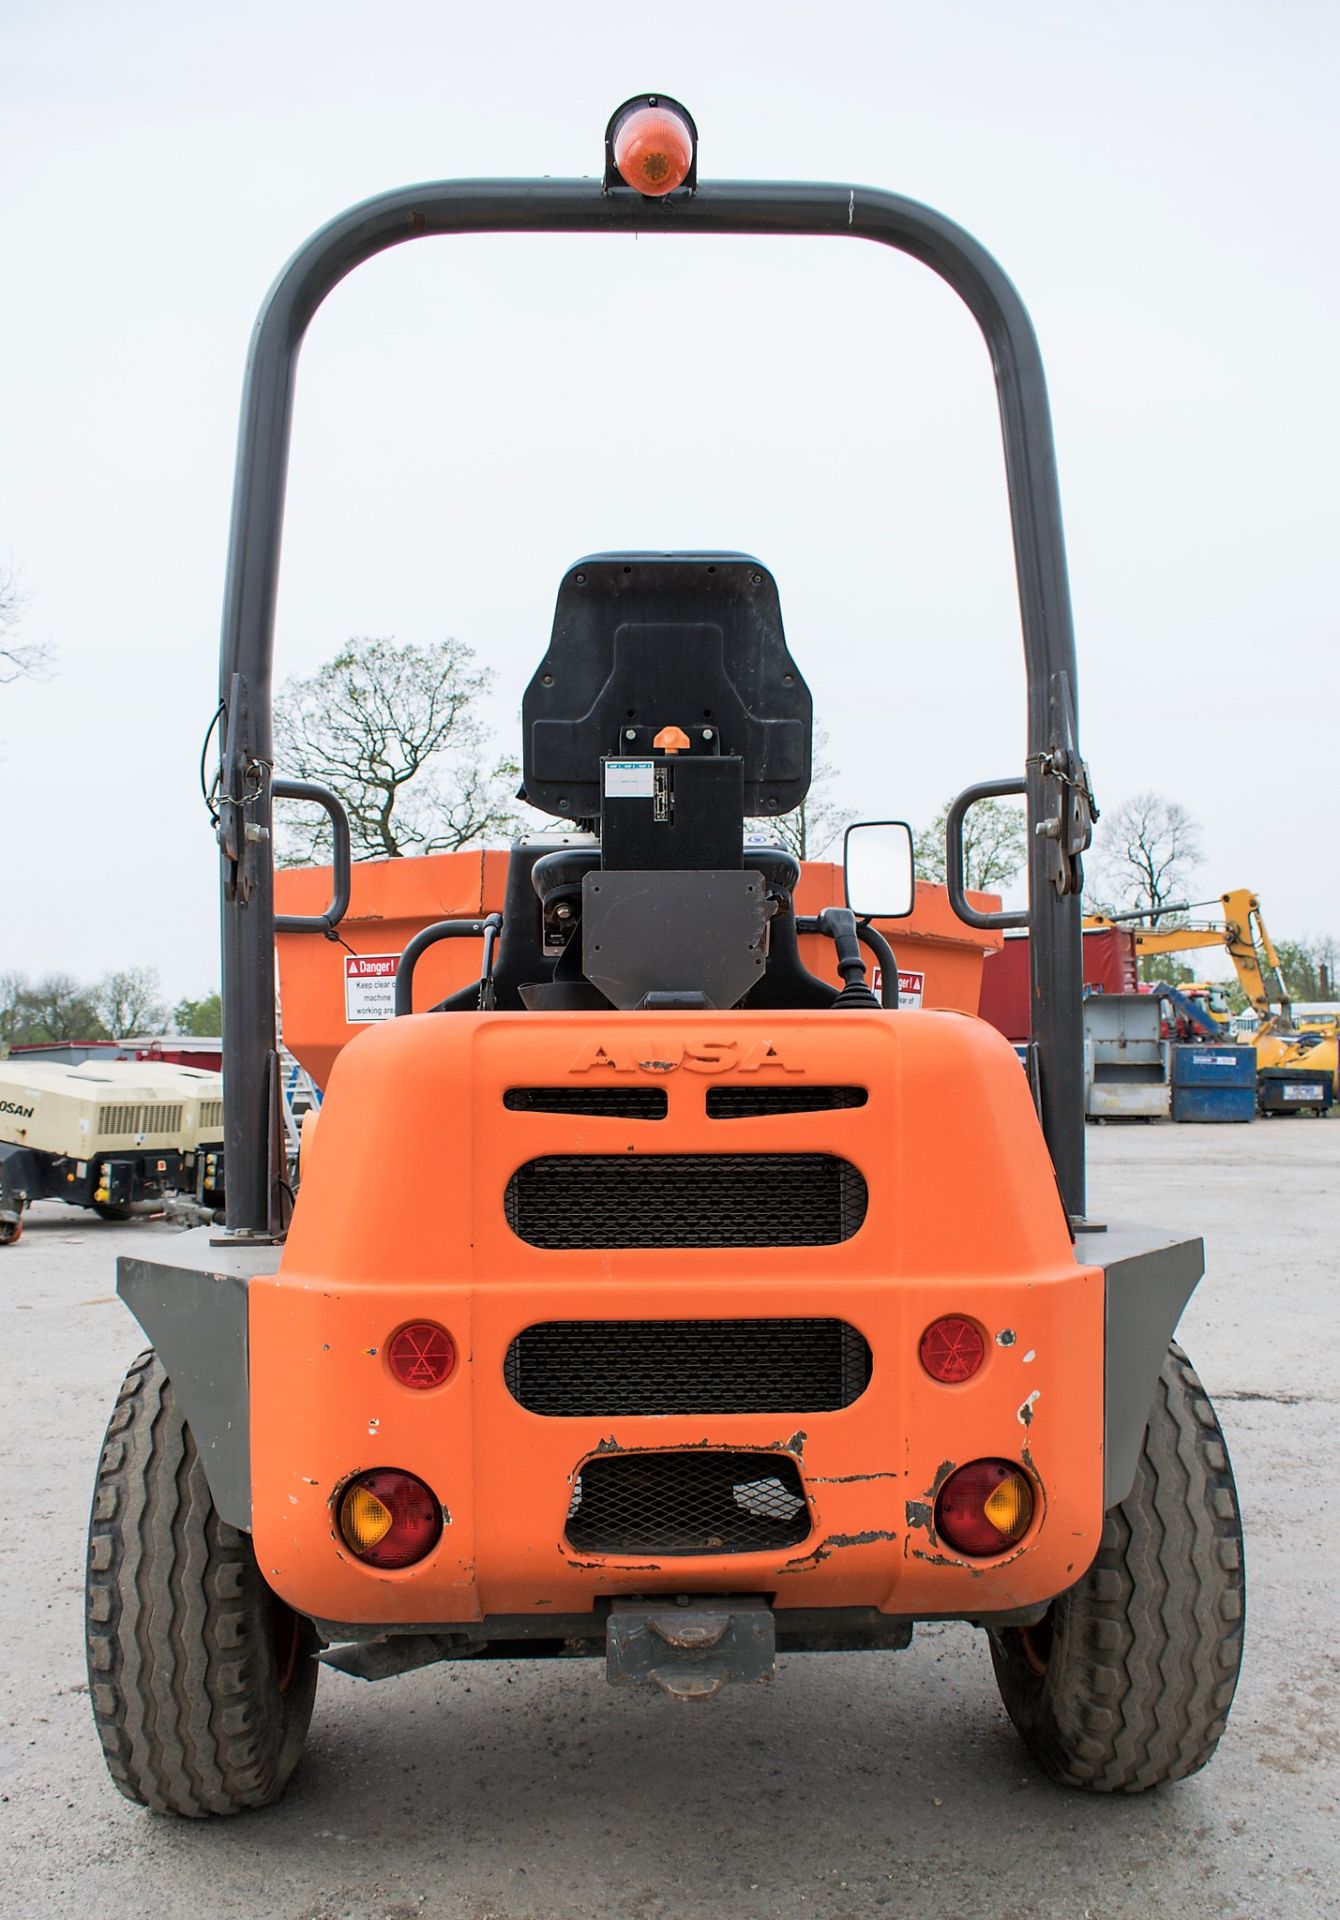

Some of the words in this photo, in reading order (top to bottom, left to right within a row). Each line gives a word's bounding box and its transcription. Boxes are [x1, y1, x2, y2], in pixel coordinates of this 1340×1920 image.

[360, 960, 394, 975] Danger!
[356, 981, 373, 990] Keep
[374, 980, 390, 989] clear
[364, 994, 391, 1002] machine
[356, 1007, 382, 1015] working
[568, 1039, 805, 1074] AUSA
